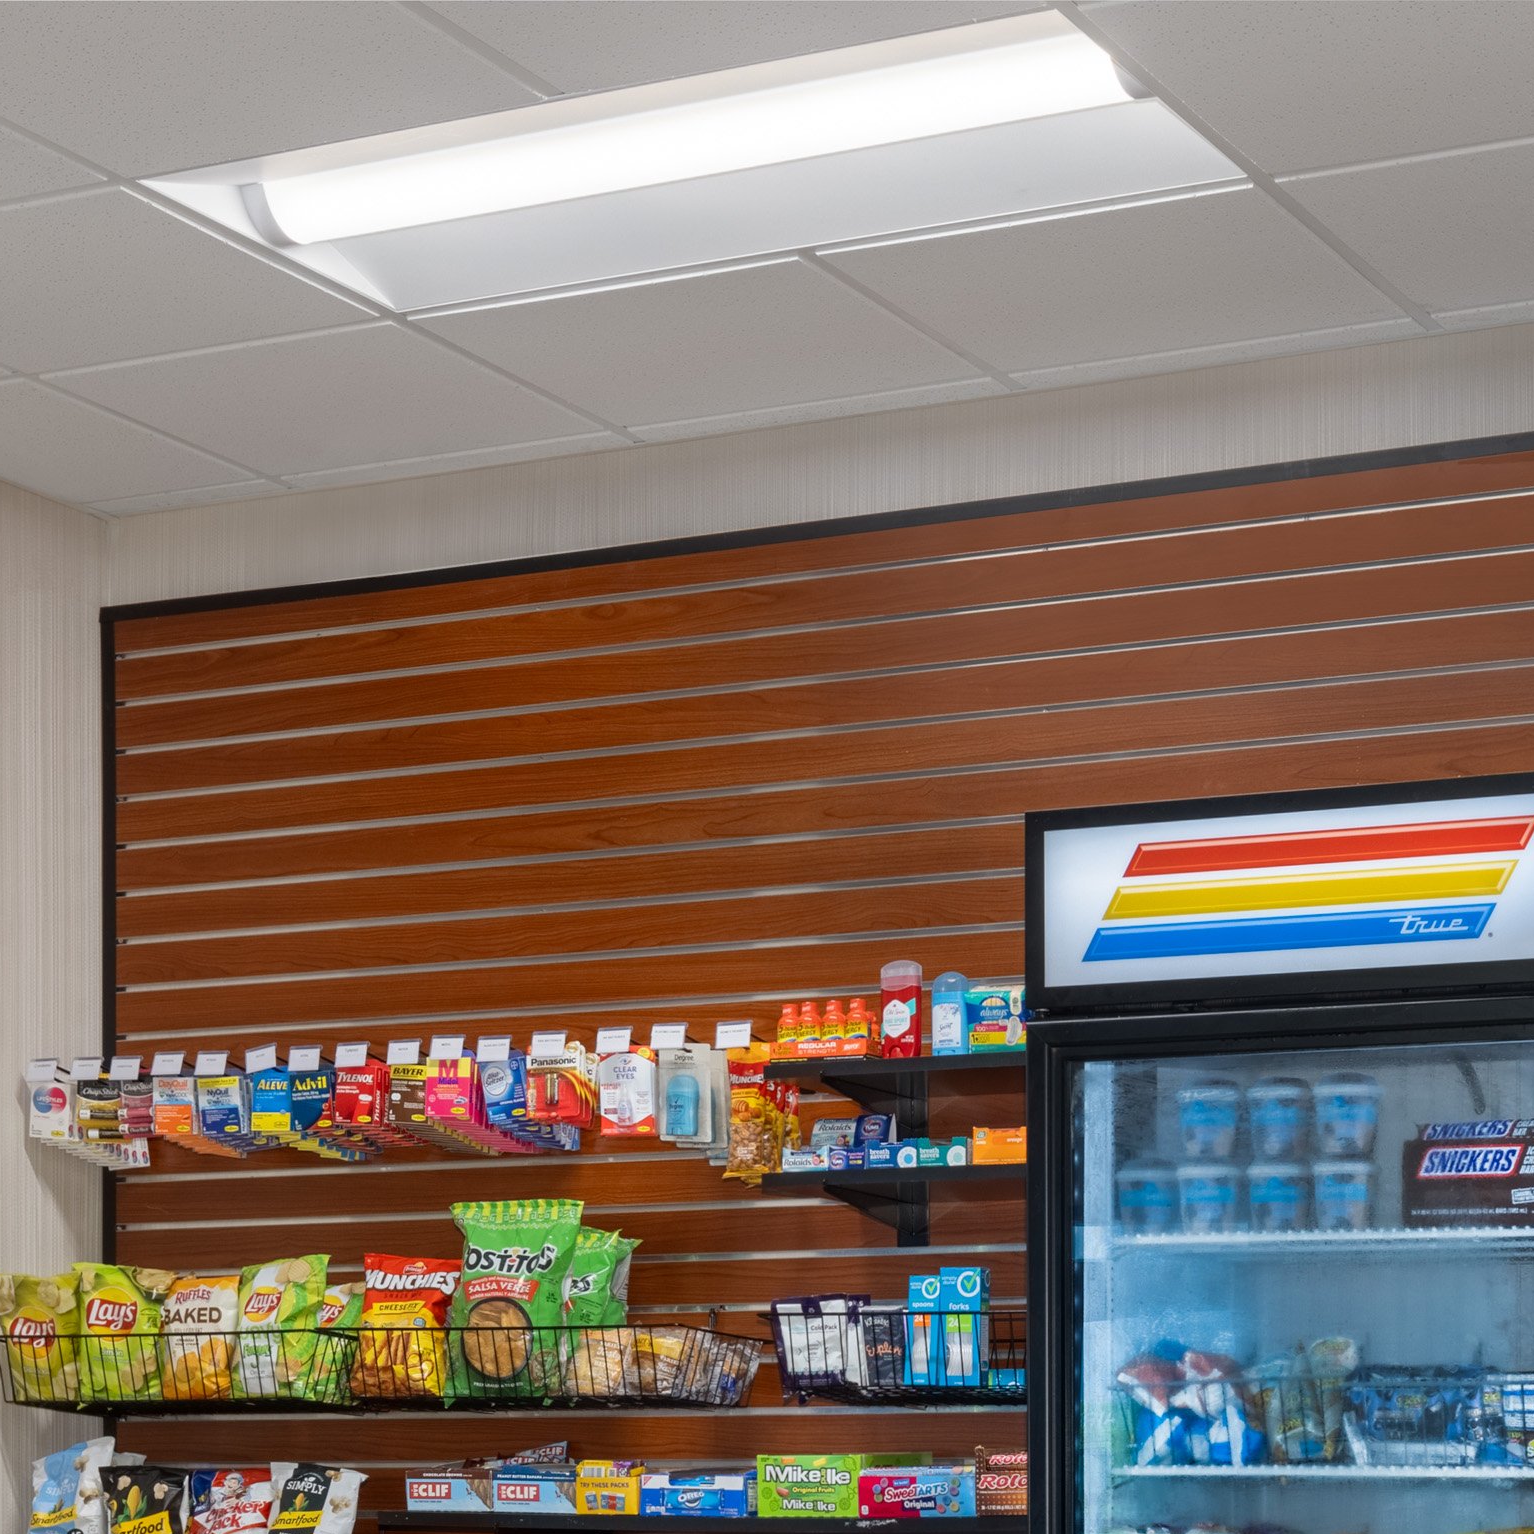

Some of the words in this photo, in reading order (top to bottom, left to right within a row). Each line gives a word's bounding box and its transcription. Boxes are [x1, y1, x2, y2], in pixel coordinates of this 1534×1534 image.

[1388, 915, 1469, 936] true
[979, 1007, 1009, 1018] always
[531, 1057, 576, 1067] Panasonic
[675, 1054, 694, 1062] Degree
[393, 1066, 423, 1076] BAYER
[616, 1072, 635, 1080] EYES
[337, 1072, 374, 1083] TYLENOL
[158, 1080, 188, 1088] DayQuil
[257, 1080, 288, 1090] ALEVE
[293, 1076, 327, 1091] Advil
[82, 1087, 118, 1095] ChapStick
[206, 1088, 229, 1097] NyQuil
[819, 1122, 852, 1132] Rolaids
[784, 1158, 812, 1167] Rolaids
[1423, 1148, 1517, 1174] SNICKERS
[367, 1270, 460, 1293] MUNCHIES
[468, 1281, 500, 1293] SALSA
[175, 1288, 212, 1304] RUFFLES
[245, 1292, 280, 1315] Lay's
[912, 1301, 934, 1309] spoons
[949, 1302, 970, 1311] forks
[87, 1298, 137, 1330] Lay's
[162, 1307, 223, 1324] BAKED
[948, 1317, 959, 1328] 24
[765, 1465, 821, 1484] Mike
[826, 1467, 851, 1485] Ike
[286, 1480, 327, 1495] SIMPLY
[418, 1484, 449, 1497] CLIF
[506, 1486, 538, 1499] CLIF
[678, 1491, 705, 1502] OREO
[783, 1499, 814, 1511] Mike
[817, 1500, 836, 1511] Ike
[903, 1500, 934, 1509] Original
